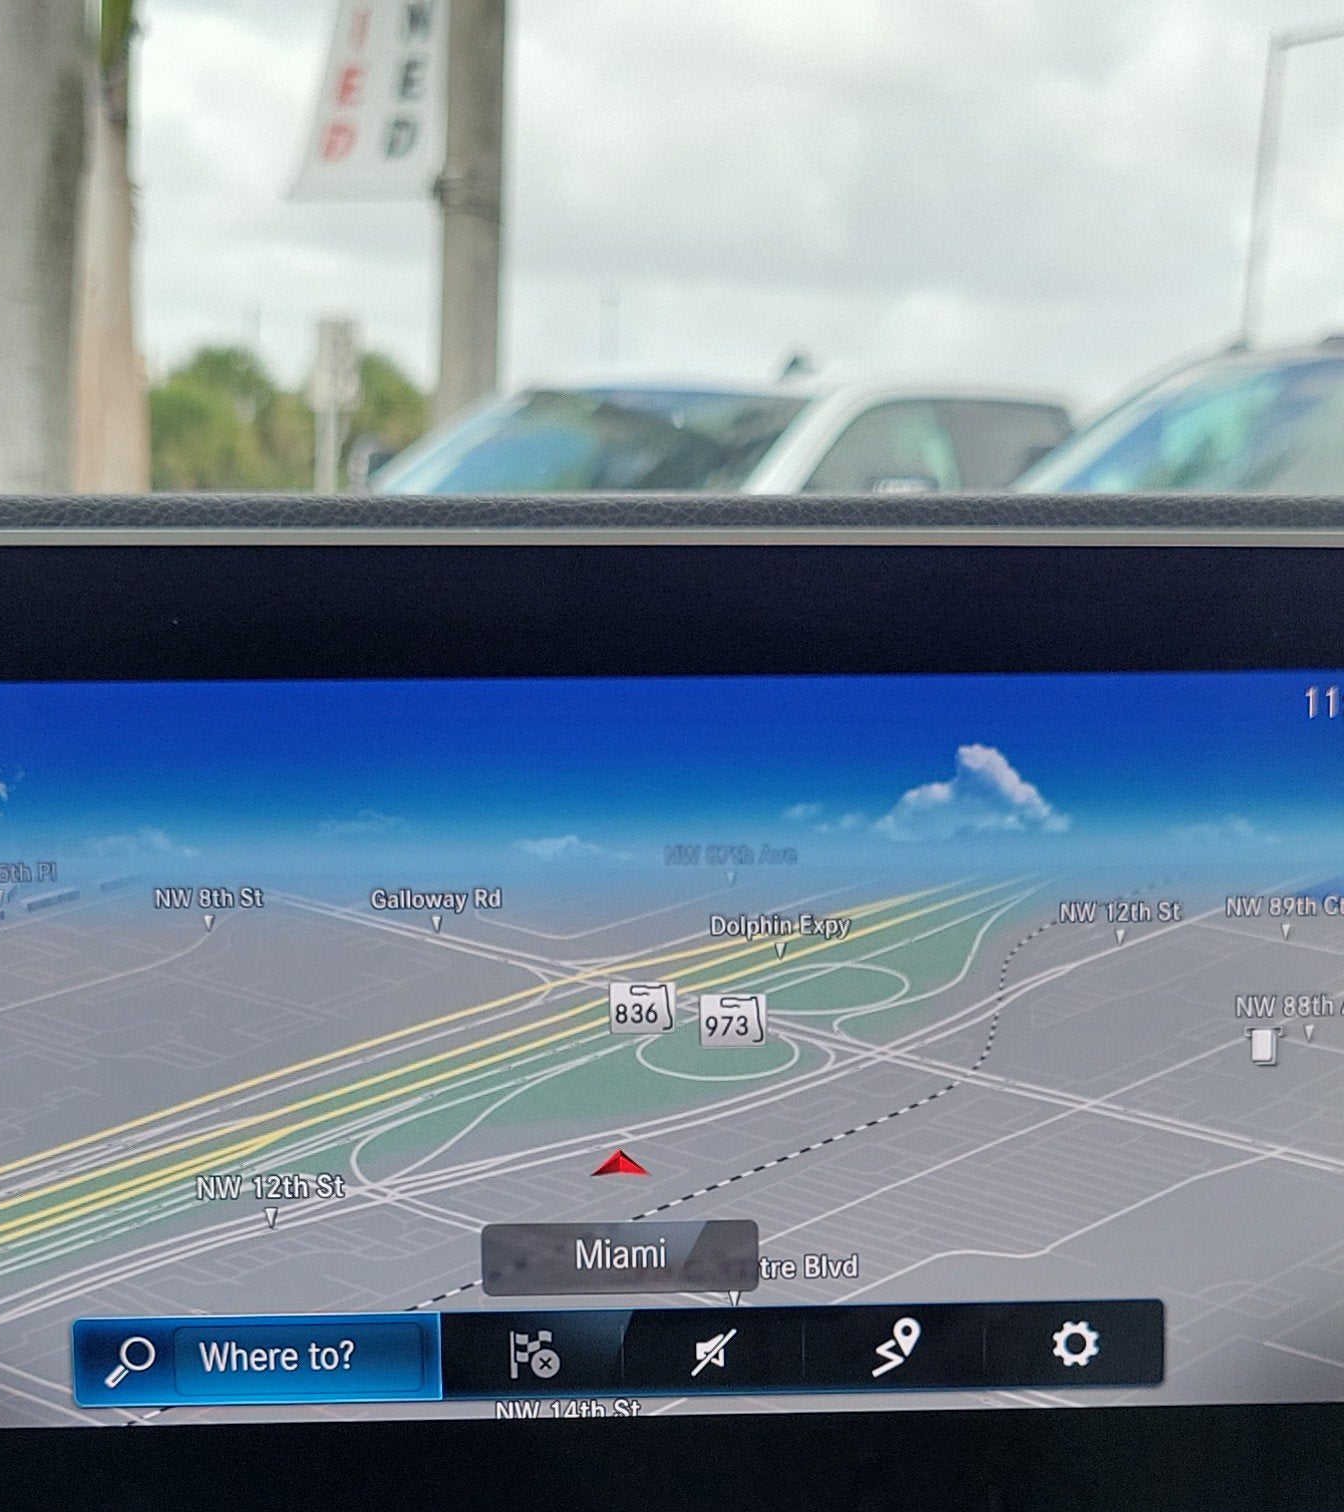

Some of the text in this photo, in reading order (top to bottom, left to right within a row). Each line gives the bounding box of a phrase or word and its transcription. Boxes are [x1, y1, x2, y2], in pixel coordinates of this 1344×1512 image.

[154, 888, 263, 909] NW 8th St
[371, 888, 502, 914] Galloway Rd
[1226, 897, 1263, 917] NW
[1268, 896, 1317, 917] 89th
[1059, 902, 1182, 923] NW 12th St
[710, 915, 852, 940] Dolphin Expy
[615, 1004, 658, 1024] 836
[1235, 997, 1278, 1018] NW
[1283, 996, 1334, 1018] 88th
[705, 1016, 749, 1037] 973
[196, 1174, 346, 1200] NW 12th St
[575, 1238, 667, 1270] Miami
[803, 1254, 859, 1279] Blvd
[199, 1339, 355, 1373] Where to?
[496, 1399, 641, 1418] NW 14th St
